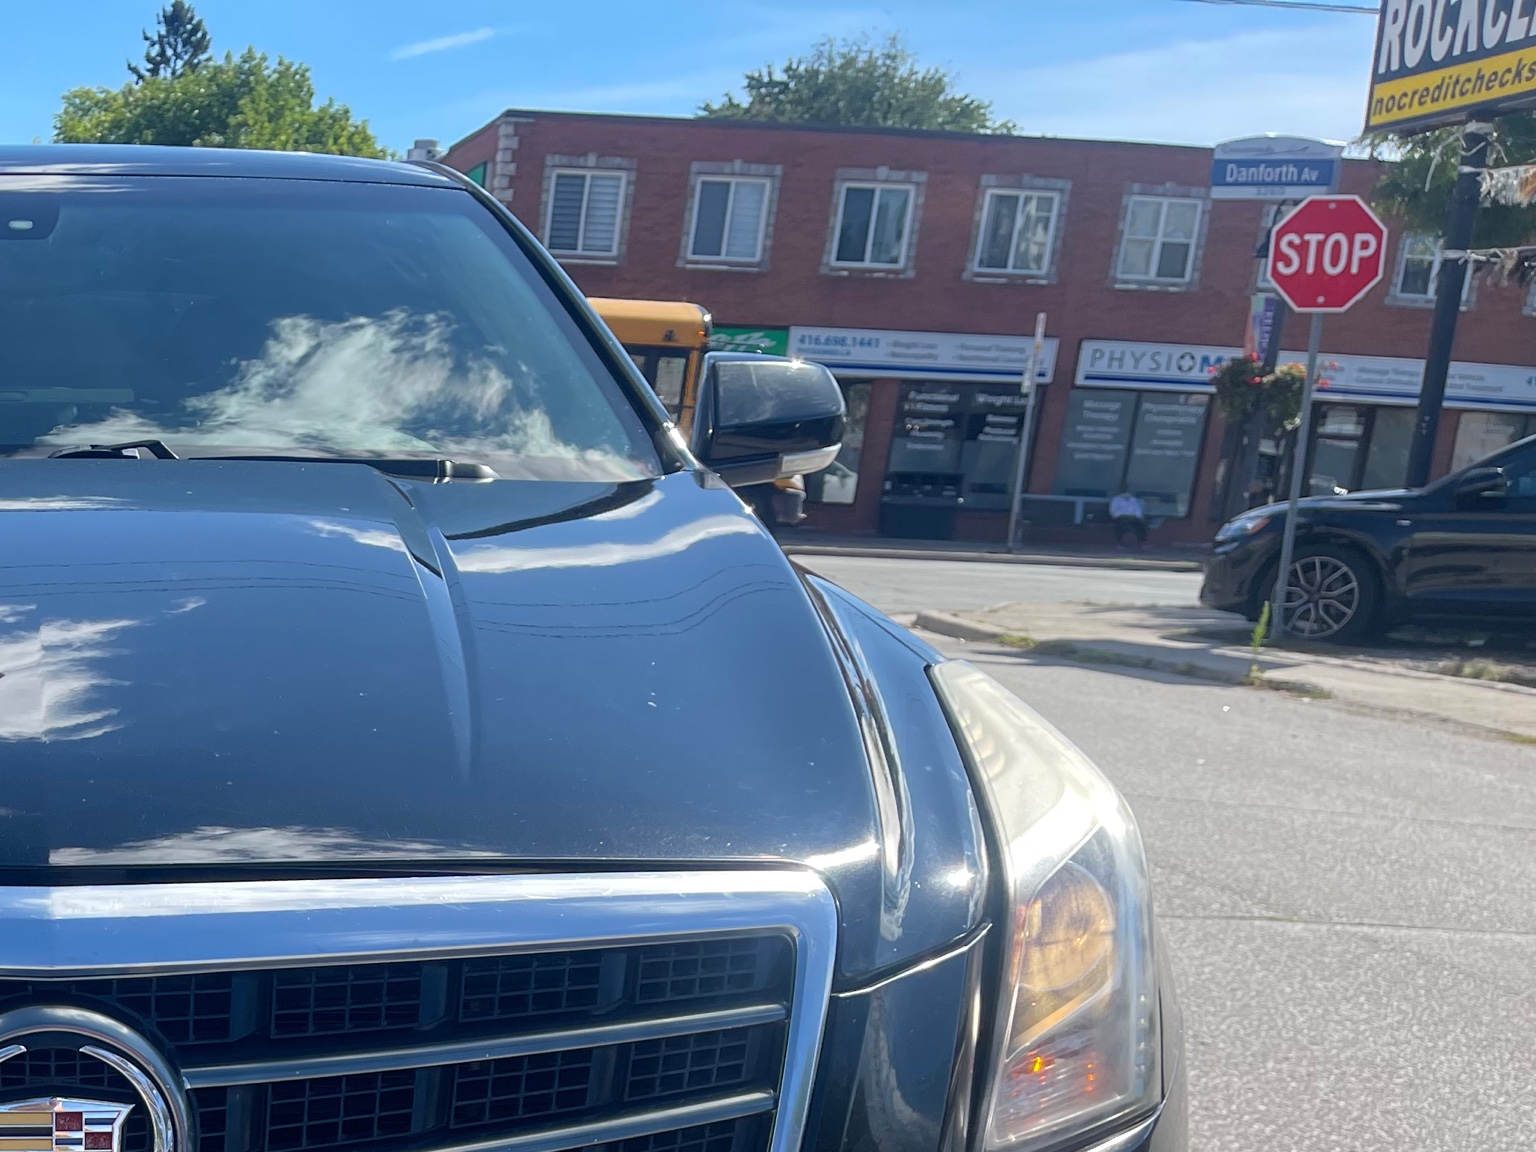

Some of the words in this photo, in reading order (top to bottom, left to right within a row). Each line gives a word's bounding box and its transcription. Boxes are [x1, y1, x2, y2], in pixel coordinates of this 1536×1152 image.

[1225, 163, 1298, 183] Danforth
[1300, 167, 1320, 182] Av
[1275, 232, 1378, 276] STOP
